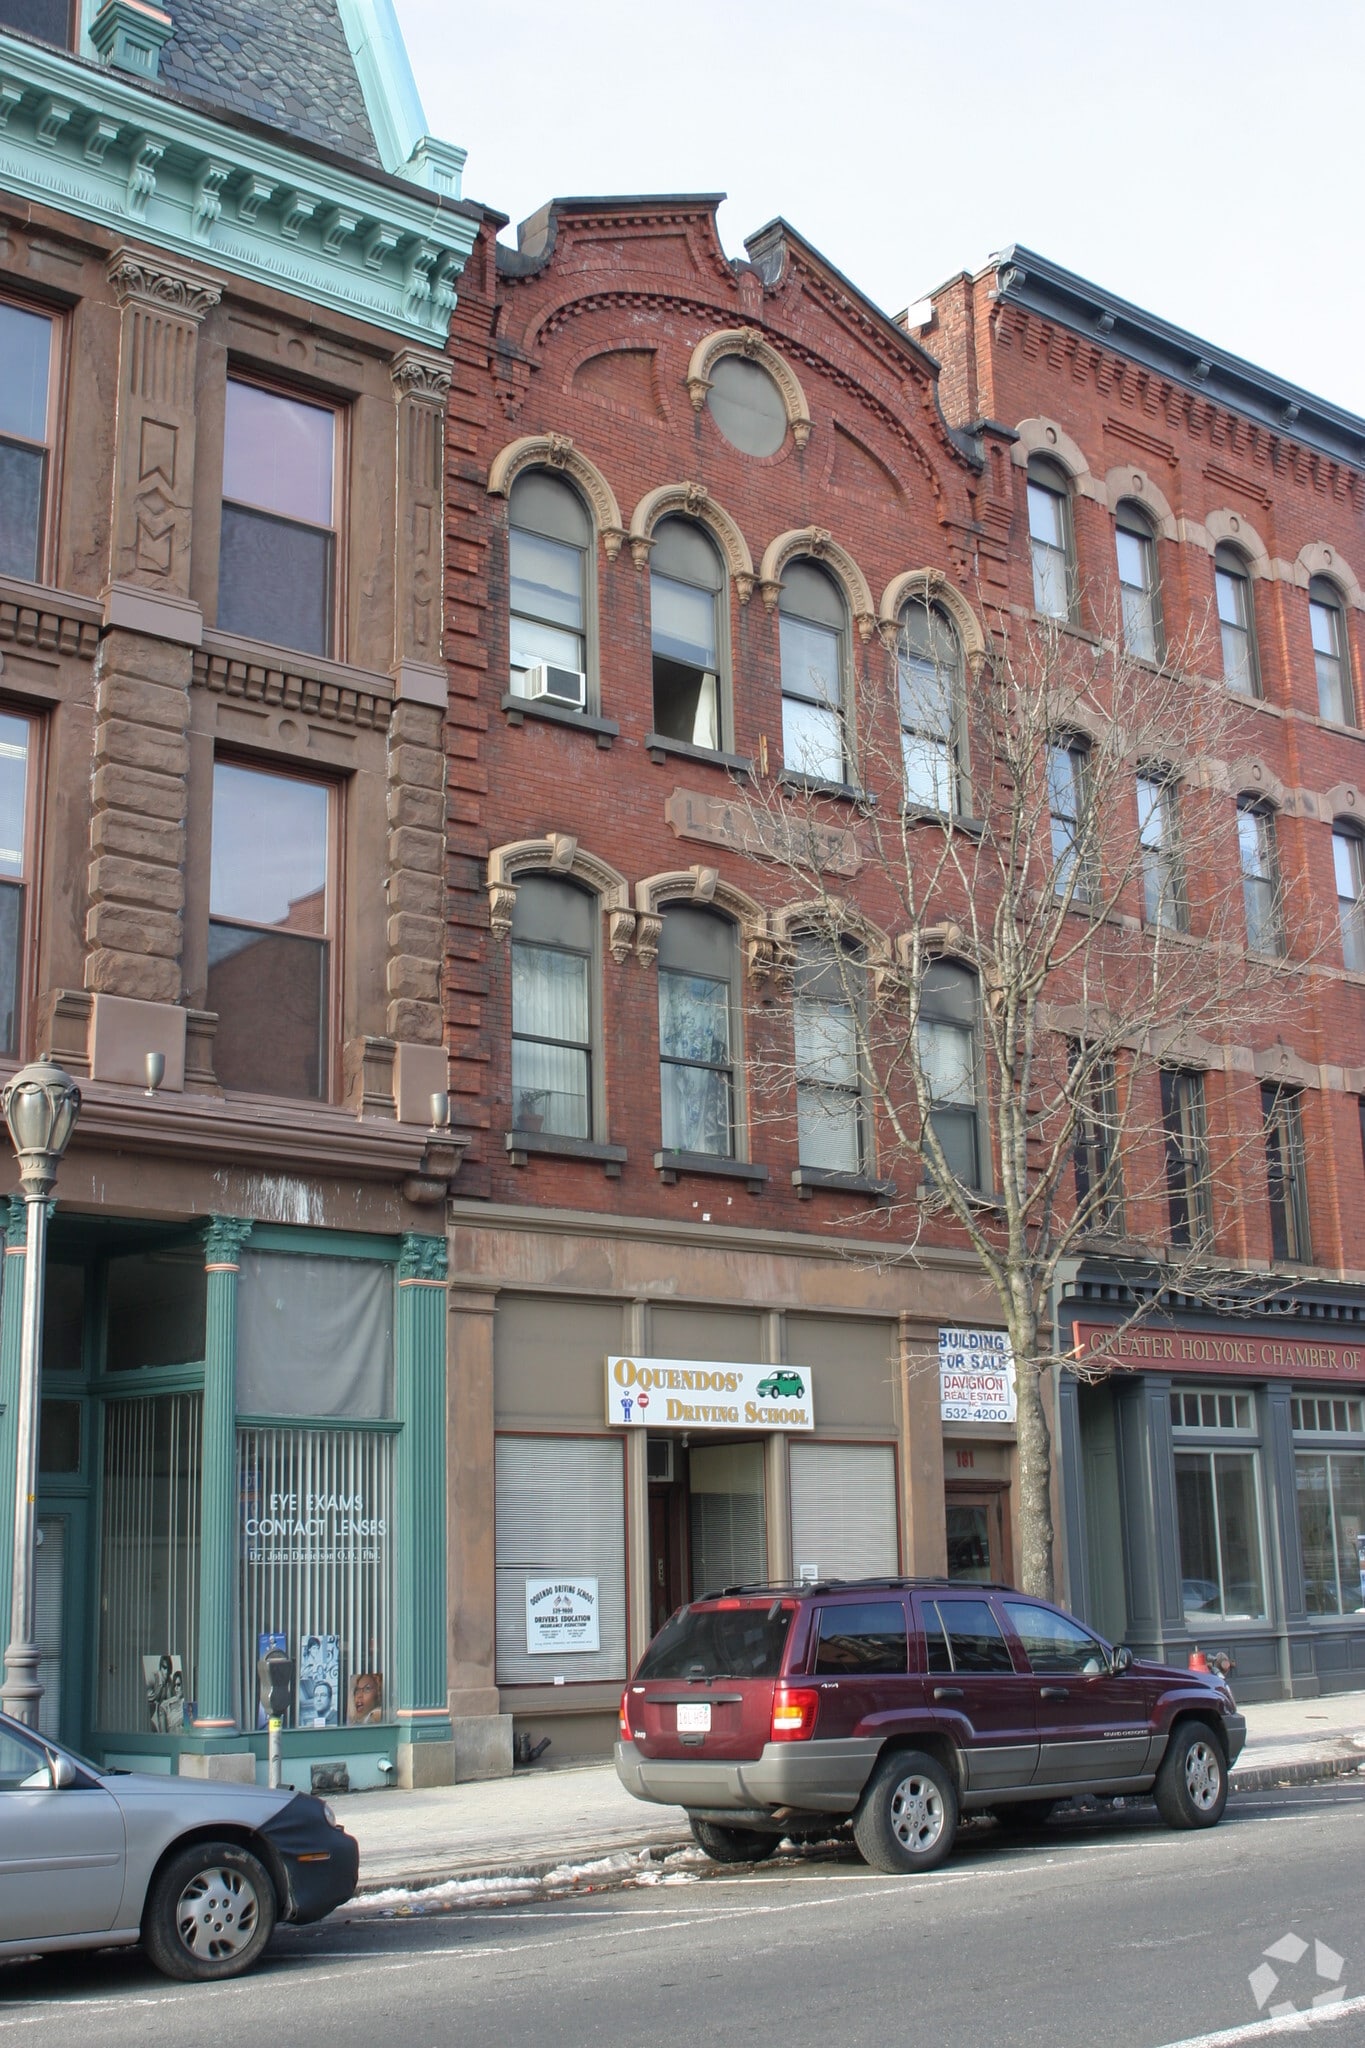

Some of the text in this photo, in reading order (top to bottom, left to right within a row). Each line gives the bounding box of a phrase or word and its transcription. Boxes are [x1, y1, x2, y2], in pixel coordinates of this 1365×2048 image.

[939, 1332, 1004, 1351] BUILDING
[1089, 1332, 1361, 1371] GREATER HOLYOKE CHAMBER OF
[940, 1353, 1007, 1371] FOR SALE
[944, 1375, 1003, 1391] DAVIGNON
[944, 1391, 1005, 1402] REAL ESTATE
[666, 1399, 809, 1425] DRIVING SCHOOL
[945, 1408, 1007, 1421] 532-4200
[270, 1494, 363, 1511] EYE EXAMS
[245, 1519, 387, 1536] CONTACT LENSES
[249, 1551, 264, 1560] Dr.
[267, 1551, 289, 1560] John
[554, 1585, 576, 1594] DRIVING
